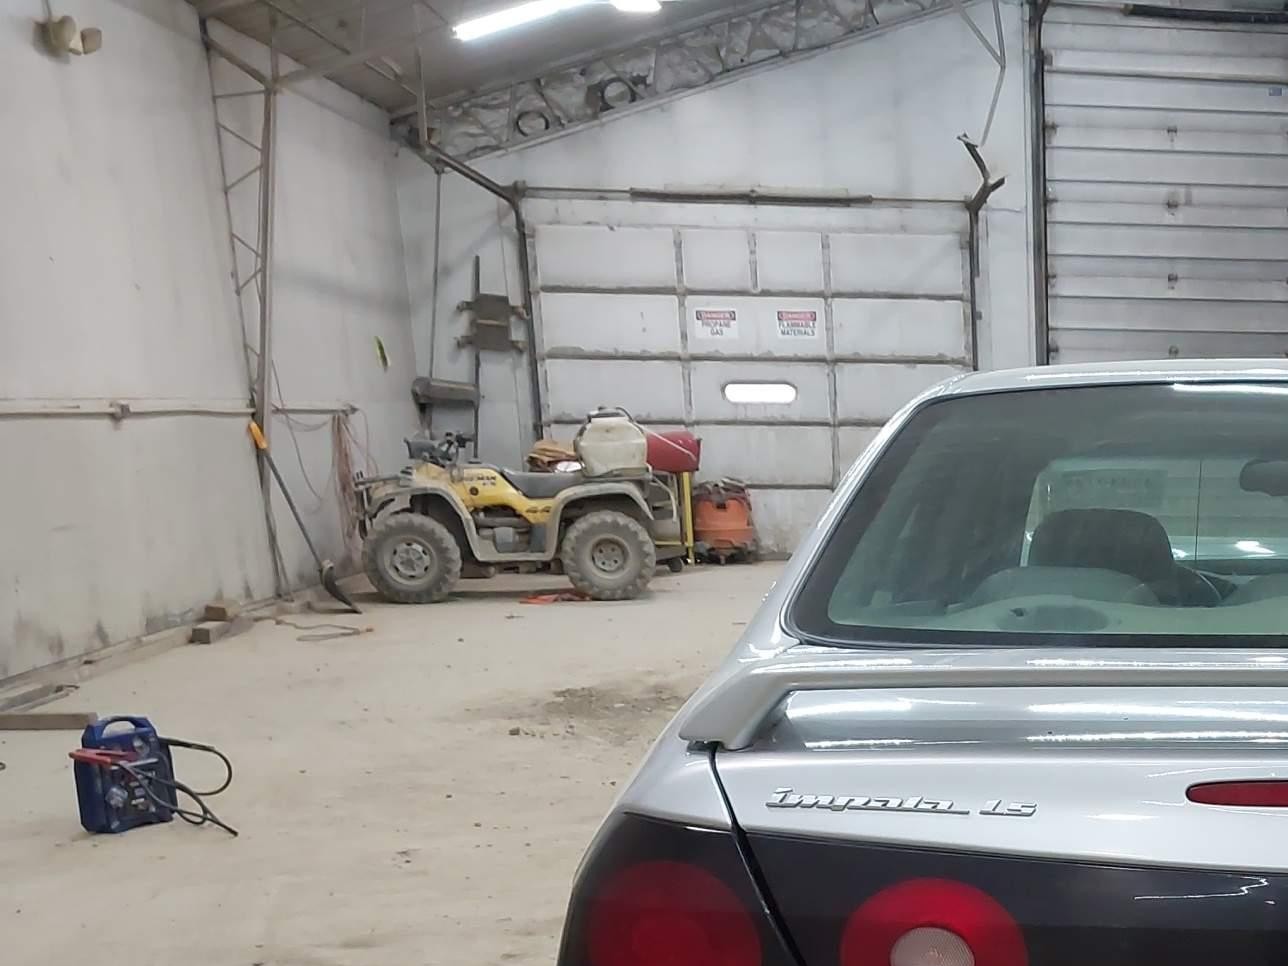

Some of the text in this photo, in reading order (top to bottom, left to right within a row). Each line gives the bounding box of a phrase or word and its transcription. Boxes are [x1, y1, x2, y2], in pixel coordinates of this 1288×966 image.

[701, 320, 731, 329] PROPANE
[778, 320, 816, 329] FLAMMABLE
[710, 328, 724, 337] GAS
[780, 328, 816, 337] MATERIALS
